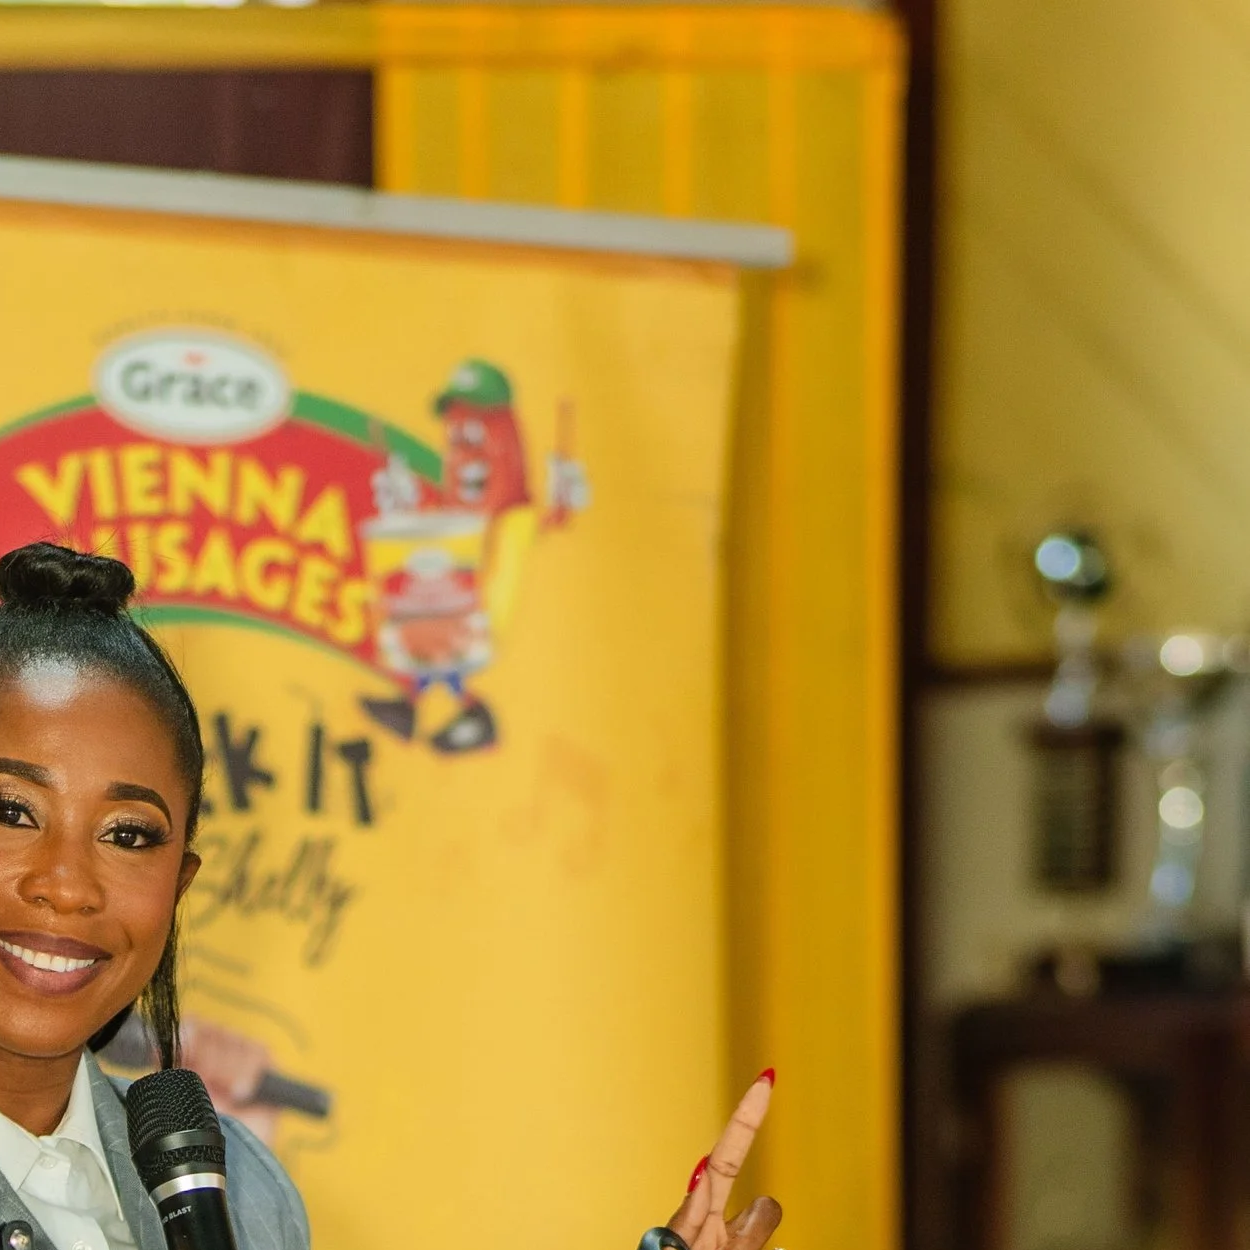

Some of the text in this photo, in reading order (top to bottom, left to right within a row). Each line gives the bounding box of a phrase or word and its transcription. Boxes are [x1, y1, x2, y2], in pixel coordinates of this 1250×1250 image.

[120, 360, 261, 410] Grace
[16, 443, 348, 558] VIENNA
[169, 1205, 192, 1220] BLAST
